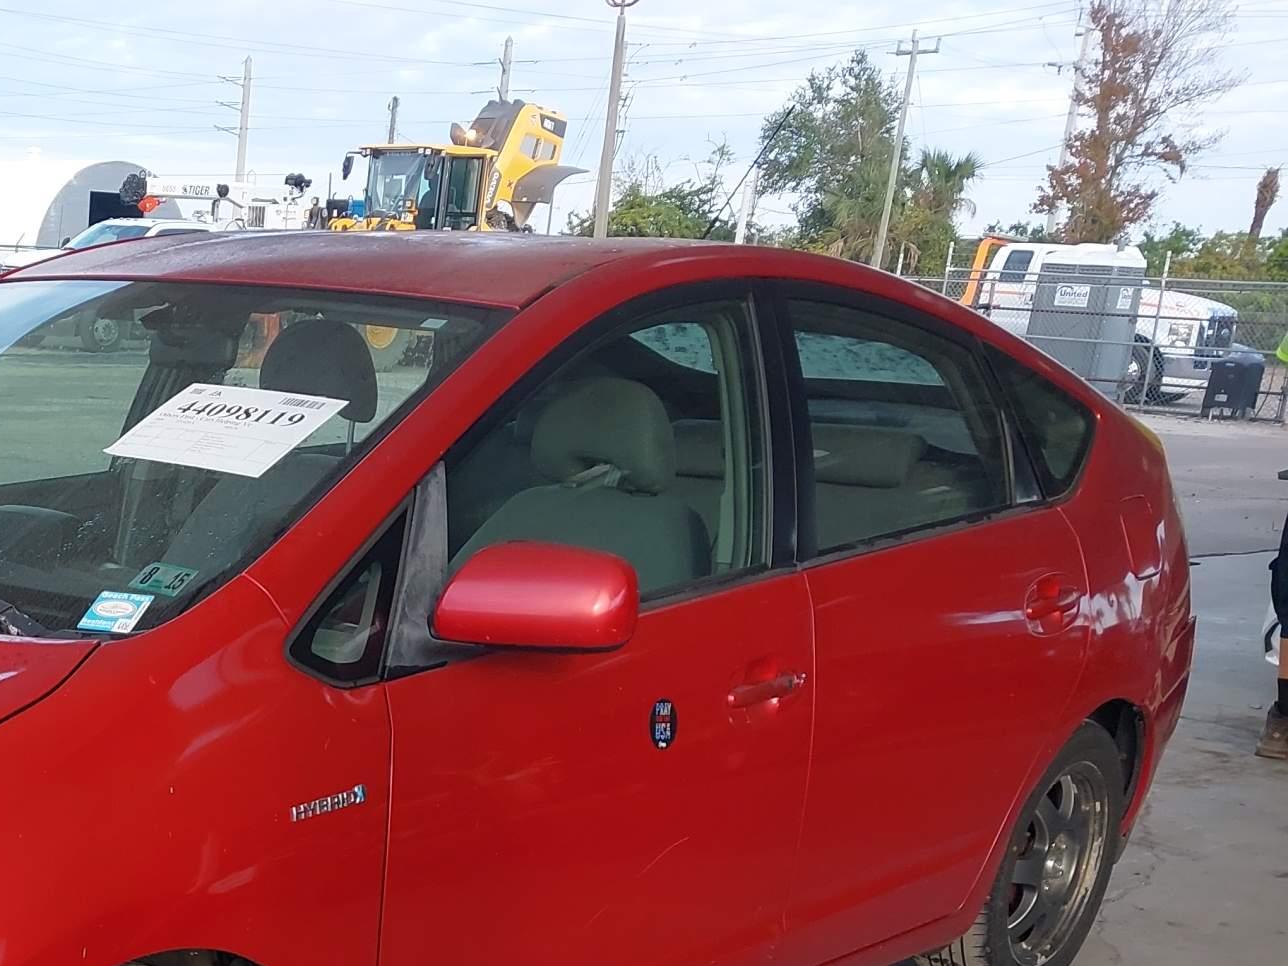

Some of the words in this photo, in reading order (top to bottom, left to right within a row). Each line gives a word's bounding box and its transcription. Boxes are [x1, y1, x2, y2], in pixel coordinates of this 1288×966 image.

[187, 184, 210, 196] TIGER
[486, 172, 500, 203] VOLVO
[1059, 289, 1088, 298] United
[178, 400, 305, 426] 44098119
[139, 566, 160, 585] 8
[163, 571, 191, 590] 15
[656, 723, 671, 740] USA
[290, 789, 355, 822] HYBRID
